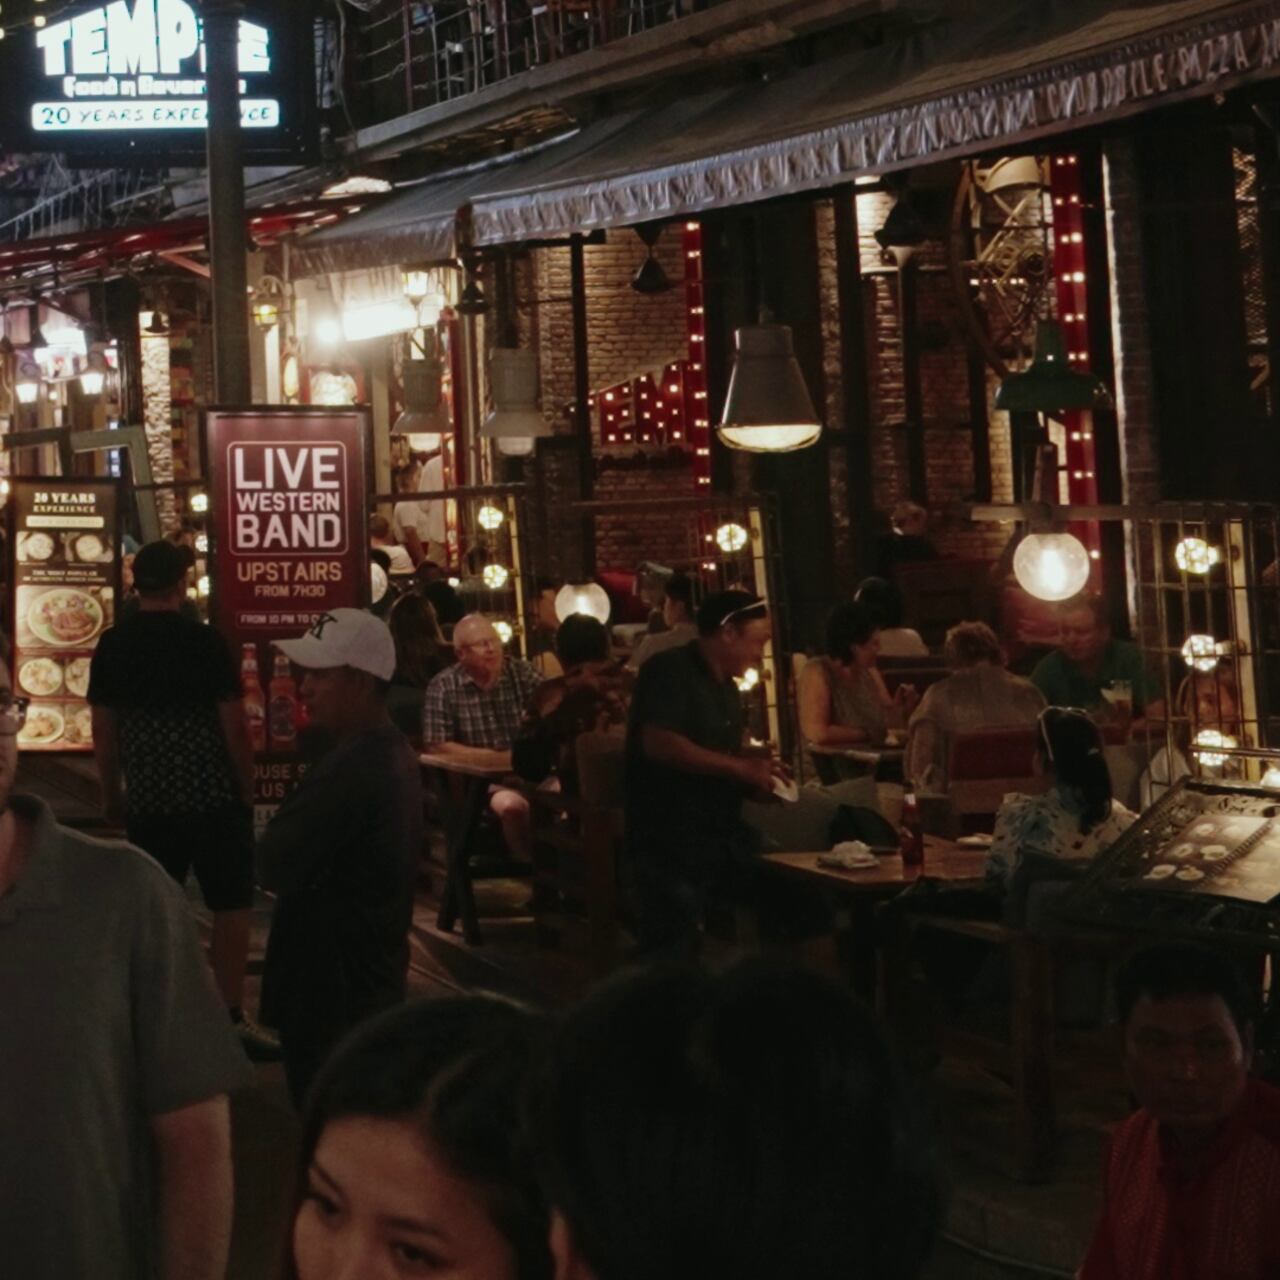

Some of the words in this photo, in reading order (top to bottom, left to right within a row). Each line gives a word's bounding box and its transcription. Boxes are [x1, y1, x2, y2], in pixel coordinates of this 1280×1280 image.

[41, 107, 71, 125] 20
[234, 447, 340, 489] LIVE
[51, 491, 97, 505] YEARS
[236, 491, 340, 512] WESTERN
[32, 504, 97, 514] EXPERIENCE
[236, 513, 342, 549] BAND
[236, 561, 343, 583] UPSTAIRS
[254, 584, 290, 598] FROM
[240, 613, 267, 625] FROM
